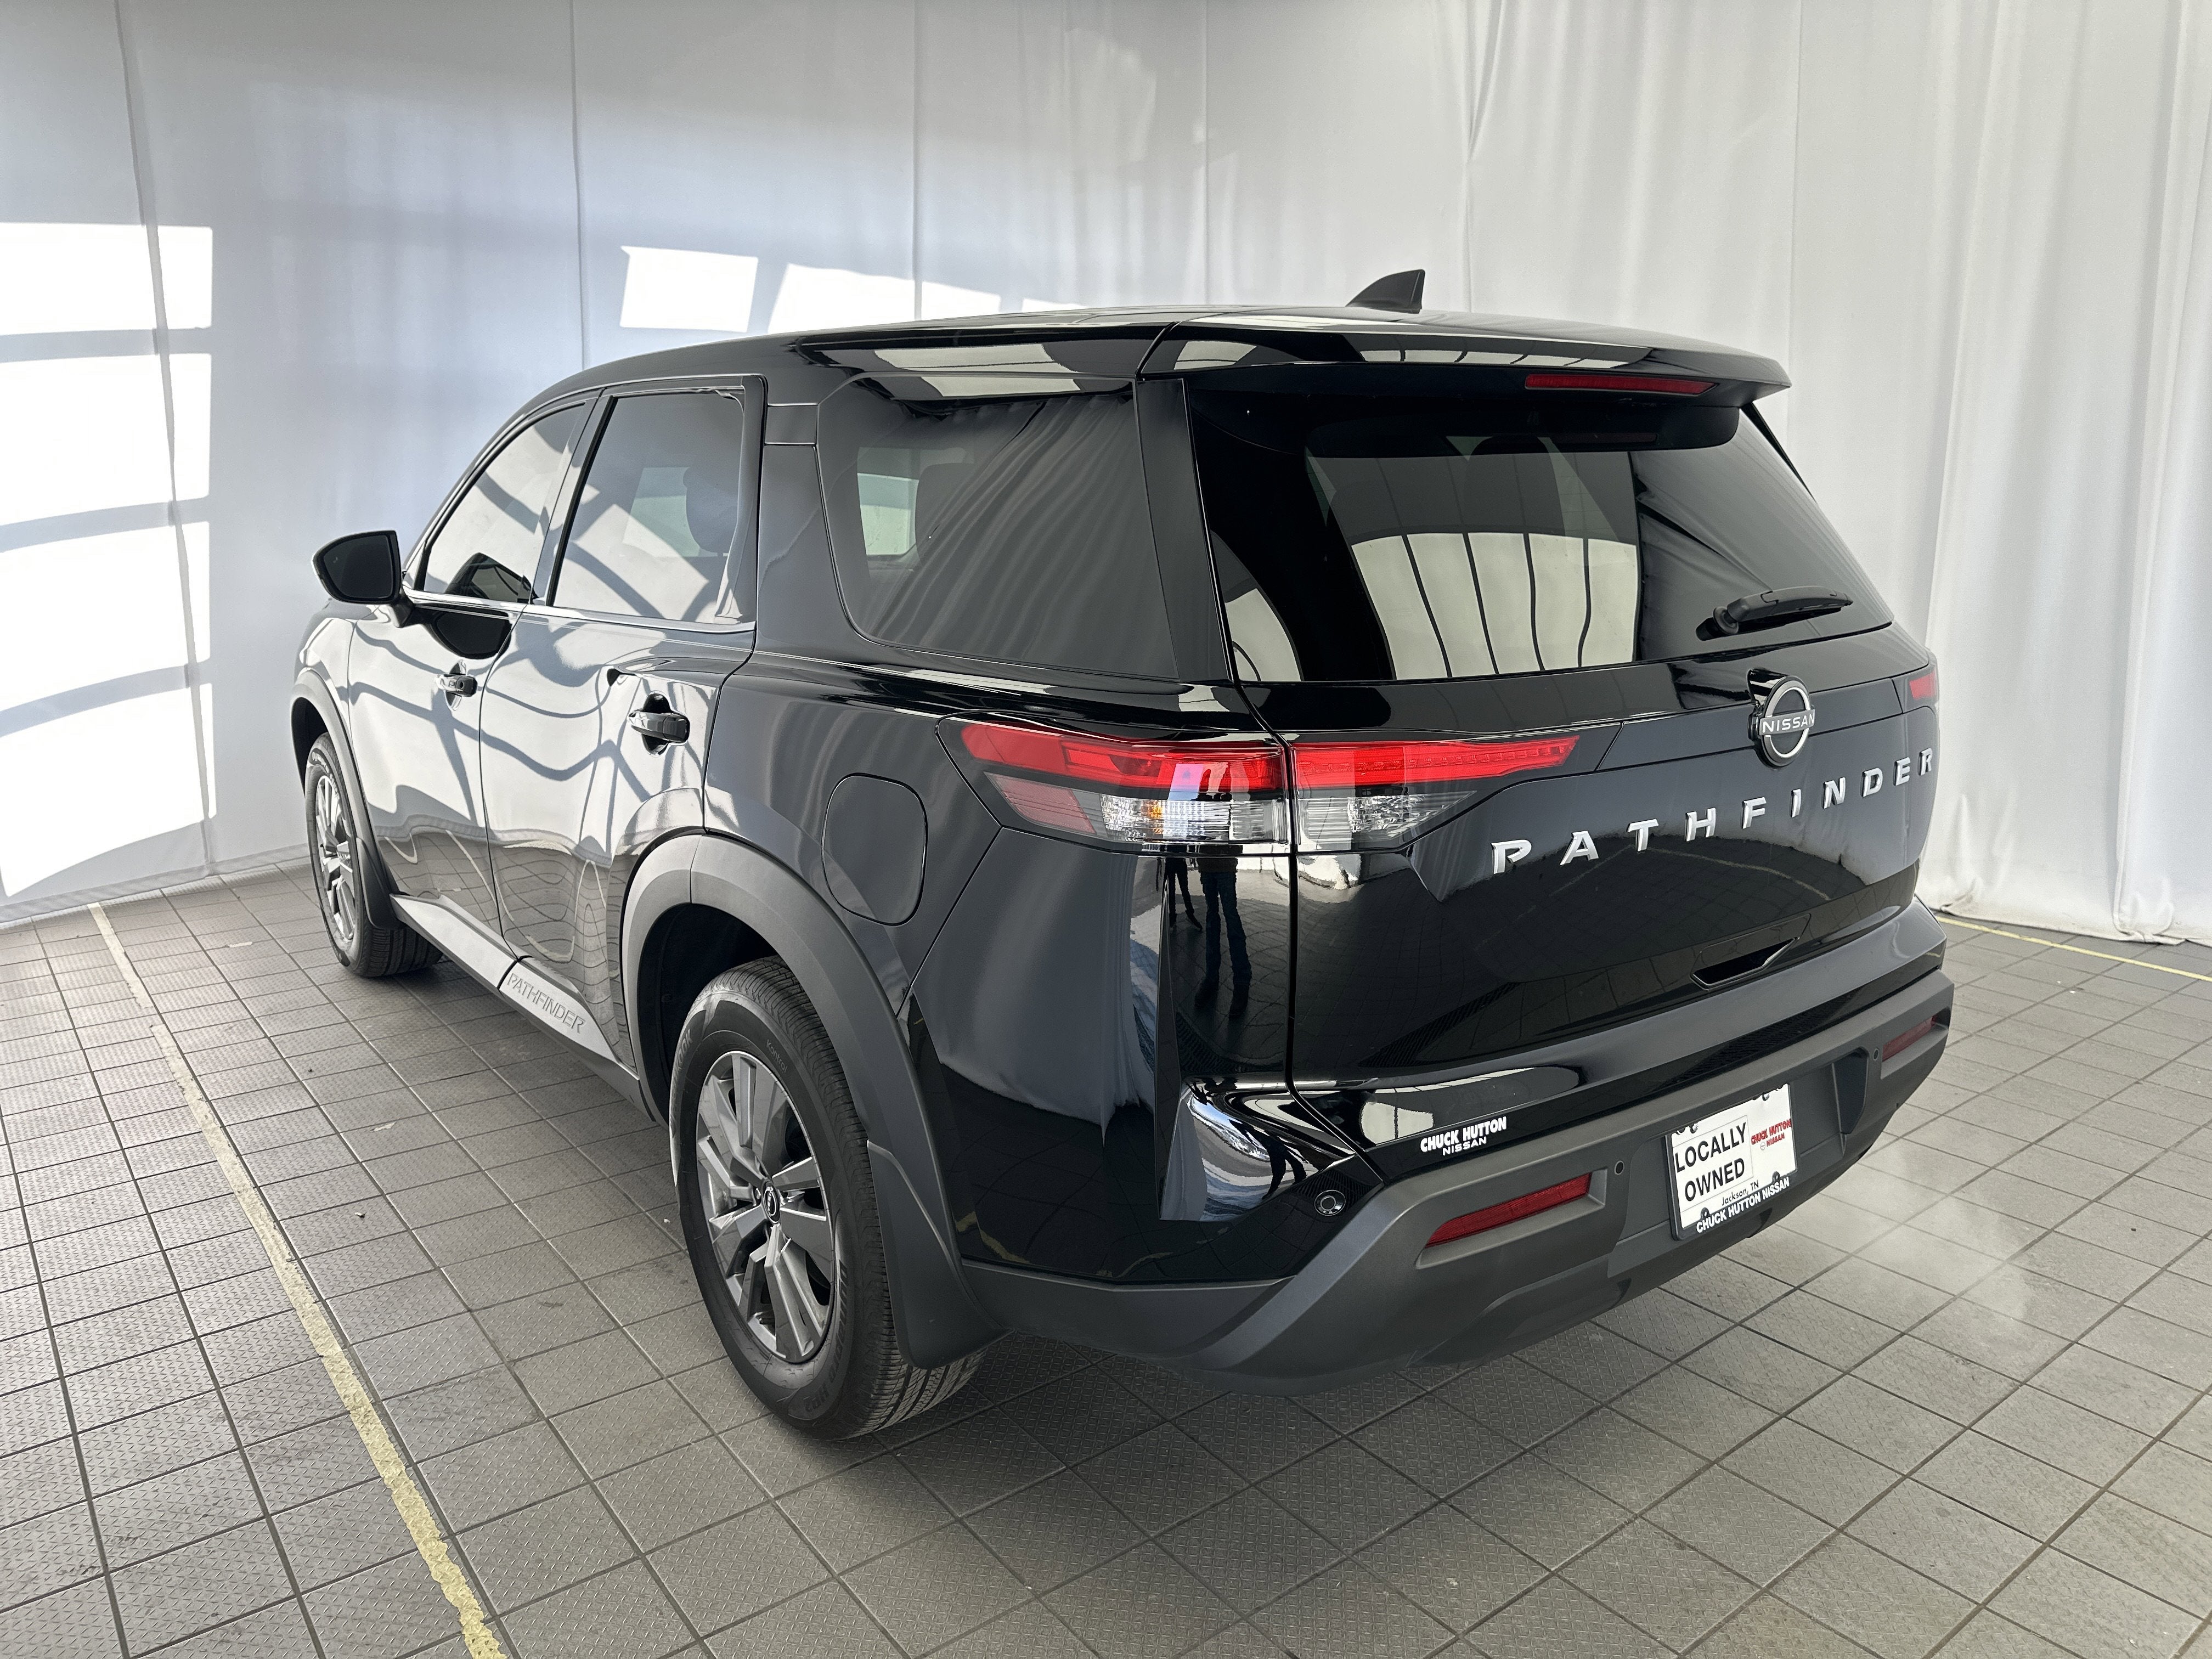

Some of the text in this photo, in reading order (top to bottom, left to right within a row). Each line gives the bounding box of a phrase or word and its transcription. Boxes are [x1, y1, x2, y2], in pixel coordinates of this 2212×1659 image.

[1762, 713, 1815, 733] NISSAN
[1492, 747, 1933, 874] PATHFINDER
[507, 972, 585, 1034] PATHFINDER
[766, 1039, 788, 1073] Kontrol
[1420, 1116, 1507, 1153] CHUCK HUTTON
[1442, 1136, 1487, 1156] NISSAN
[1674, 1122, 1746, 1173] LOCALLY
[1751, 1118, 1791, 1145] CHUCK HUTTON
[1766, 1132, 1785, 1147] NISSAN
[1684, 1158, 1745, 1201] OWNED
[1722, 1180, 1759, 1206] Jackson, TN
[1696, 1176, 1790, 1233] CHUCK HUTTON NISSAN
